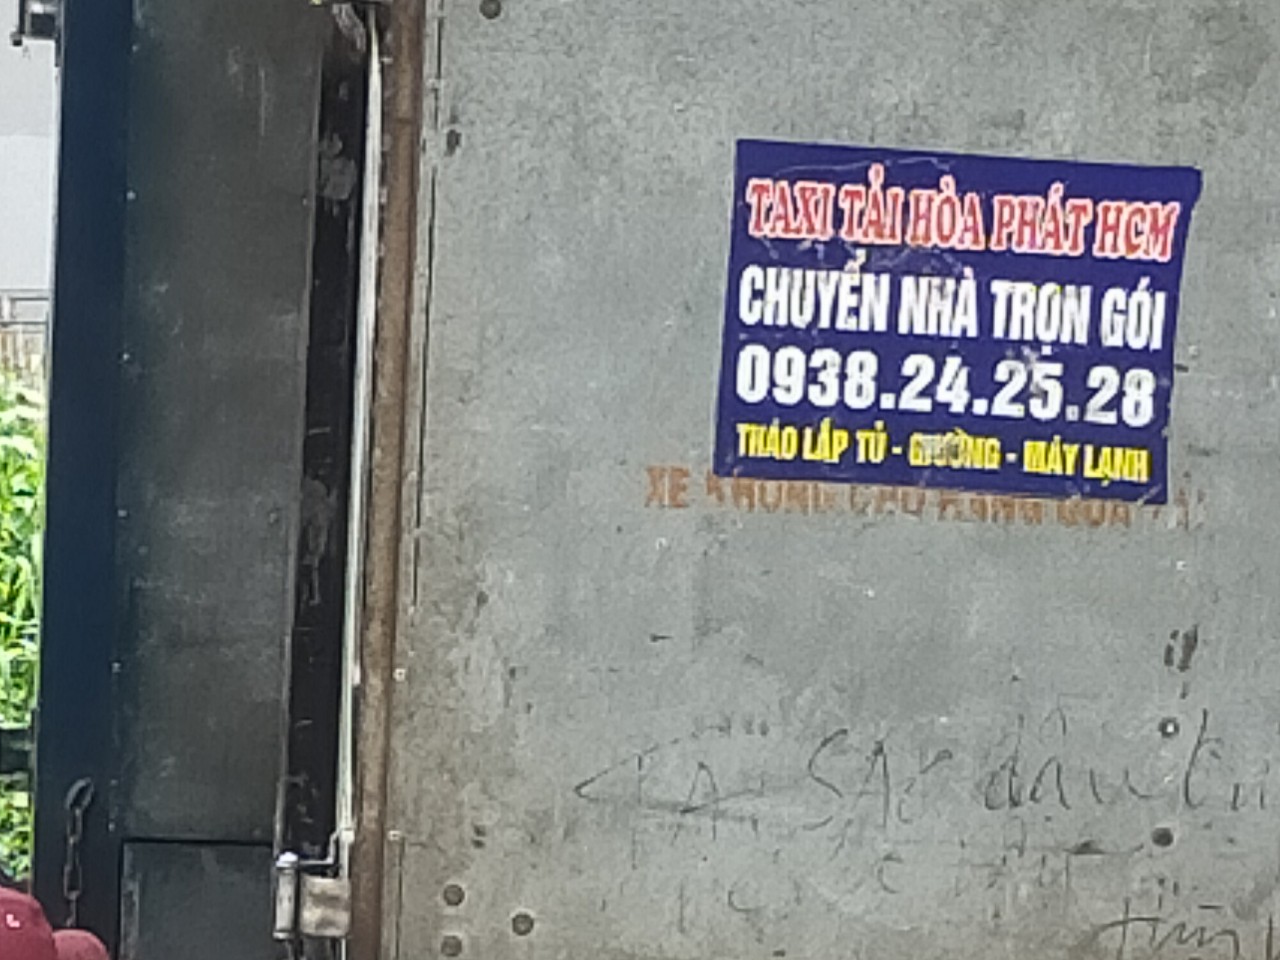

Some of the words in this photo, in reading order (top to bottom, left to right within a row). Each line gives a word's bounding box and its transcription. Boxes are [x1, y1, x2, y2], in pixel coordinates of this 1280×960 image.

[746, 178, 836, 240] TAXI
[839, 163, 905, 245] TẢI
[990, 181, 1093, 257] PHÁT
[1093, 201, 1181, 263] HCM
[738, 249, 890, 332] CHUYỂN
[898, 267, 979, 338] NHÀ
[990, 279, 1093, 356] TRỌN
[1100, 275, 1167, 352] GÓI
[735, 344, 1157, 428] 0938.24.25.28
[645, 465, 690, 508] XE
[736, 418, 798, 460] THÁO
[1023, 435, 1080, 476] MÁY
[1083, 444, 1149, 488] LẠNH
